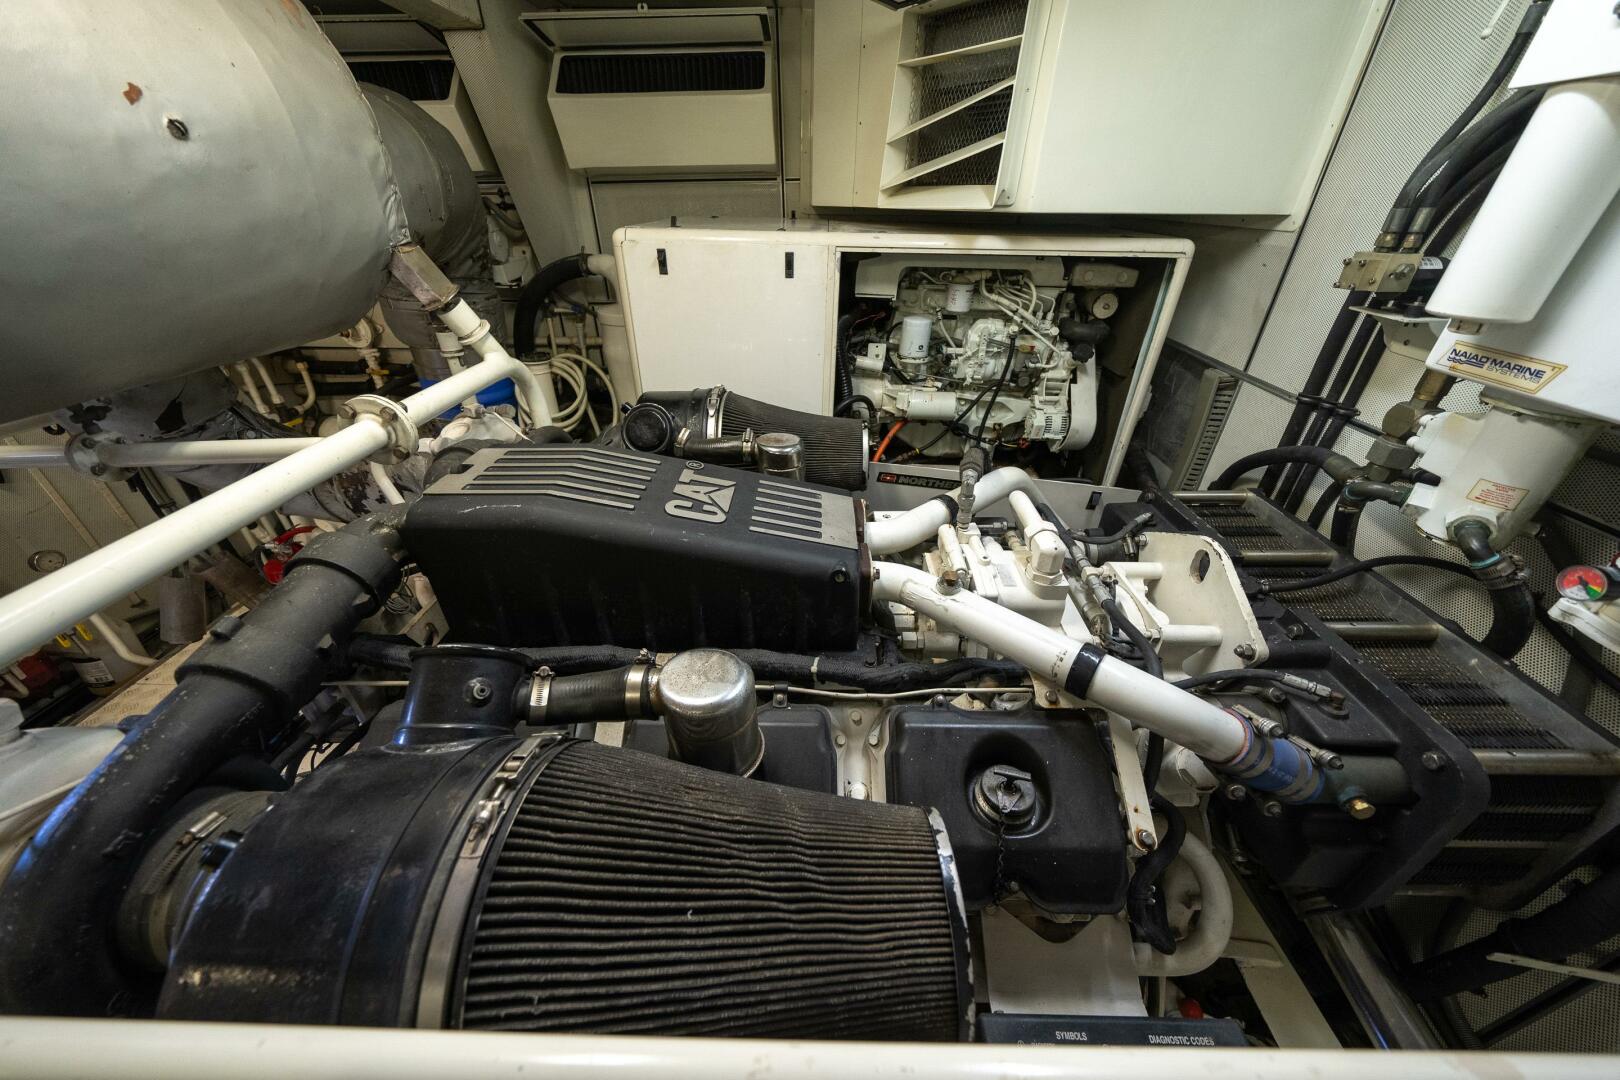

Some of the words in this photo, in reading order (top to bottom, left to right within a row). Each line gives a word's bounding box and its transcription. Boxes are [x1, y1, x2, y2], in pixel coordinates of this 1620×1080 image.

[1450, 348, 1489, 363] NAIAD
[1490, 359, 1546, 379] MARINE
[1485, 365, 1541, 384] SYSTEMS
[664, 468, 736, 523] CAT
[1055, 1031, 1088, 1041] SYMBOLS
[1148, 1034, 1190, 1045] DIAGNOSTIC
[1190, 1036, 1215, 1046] CODES
